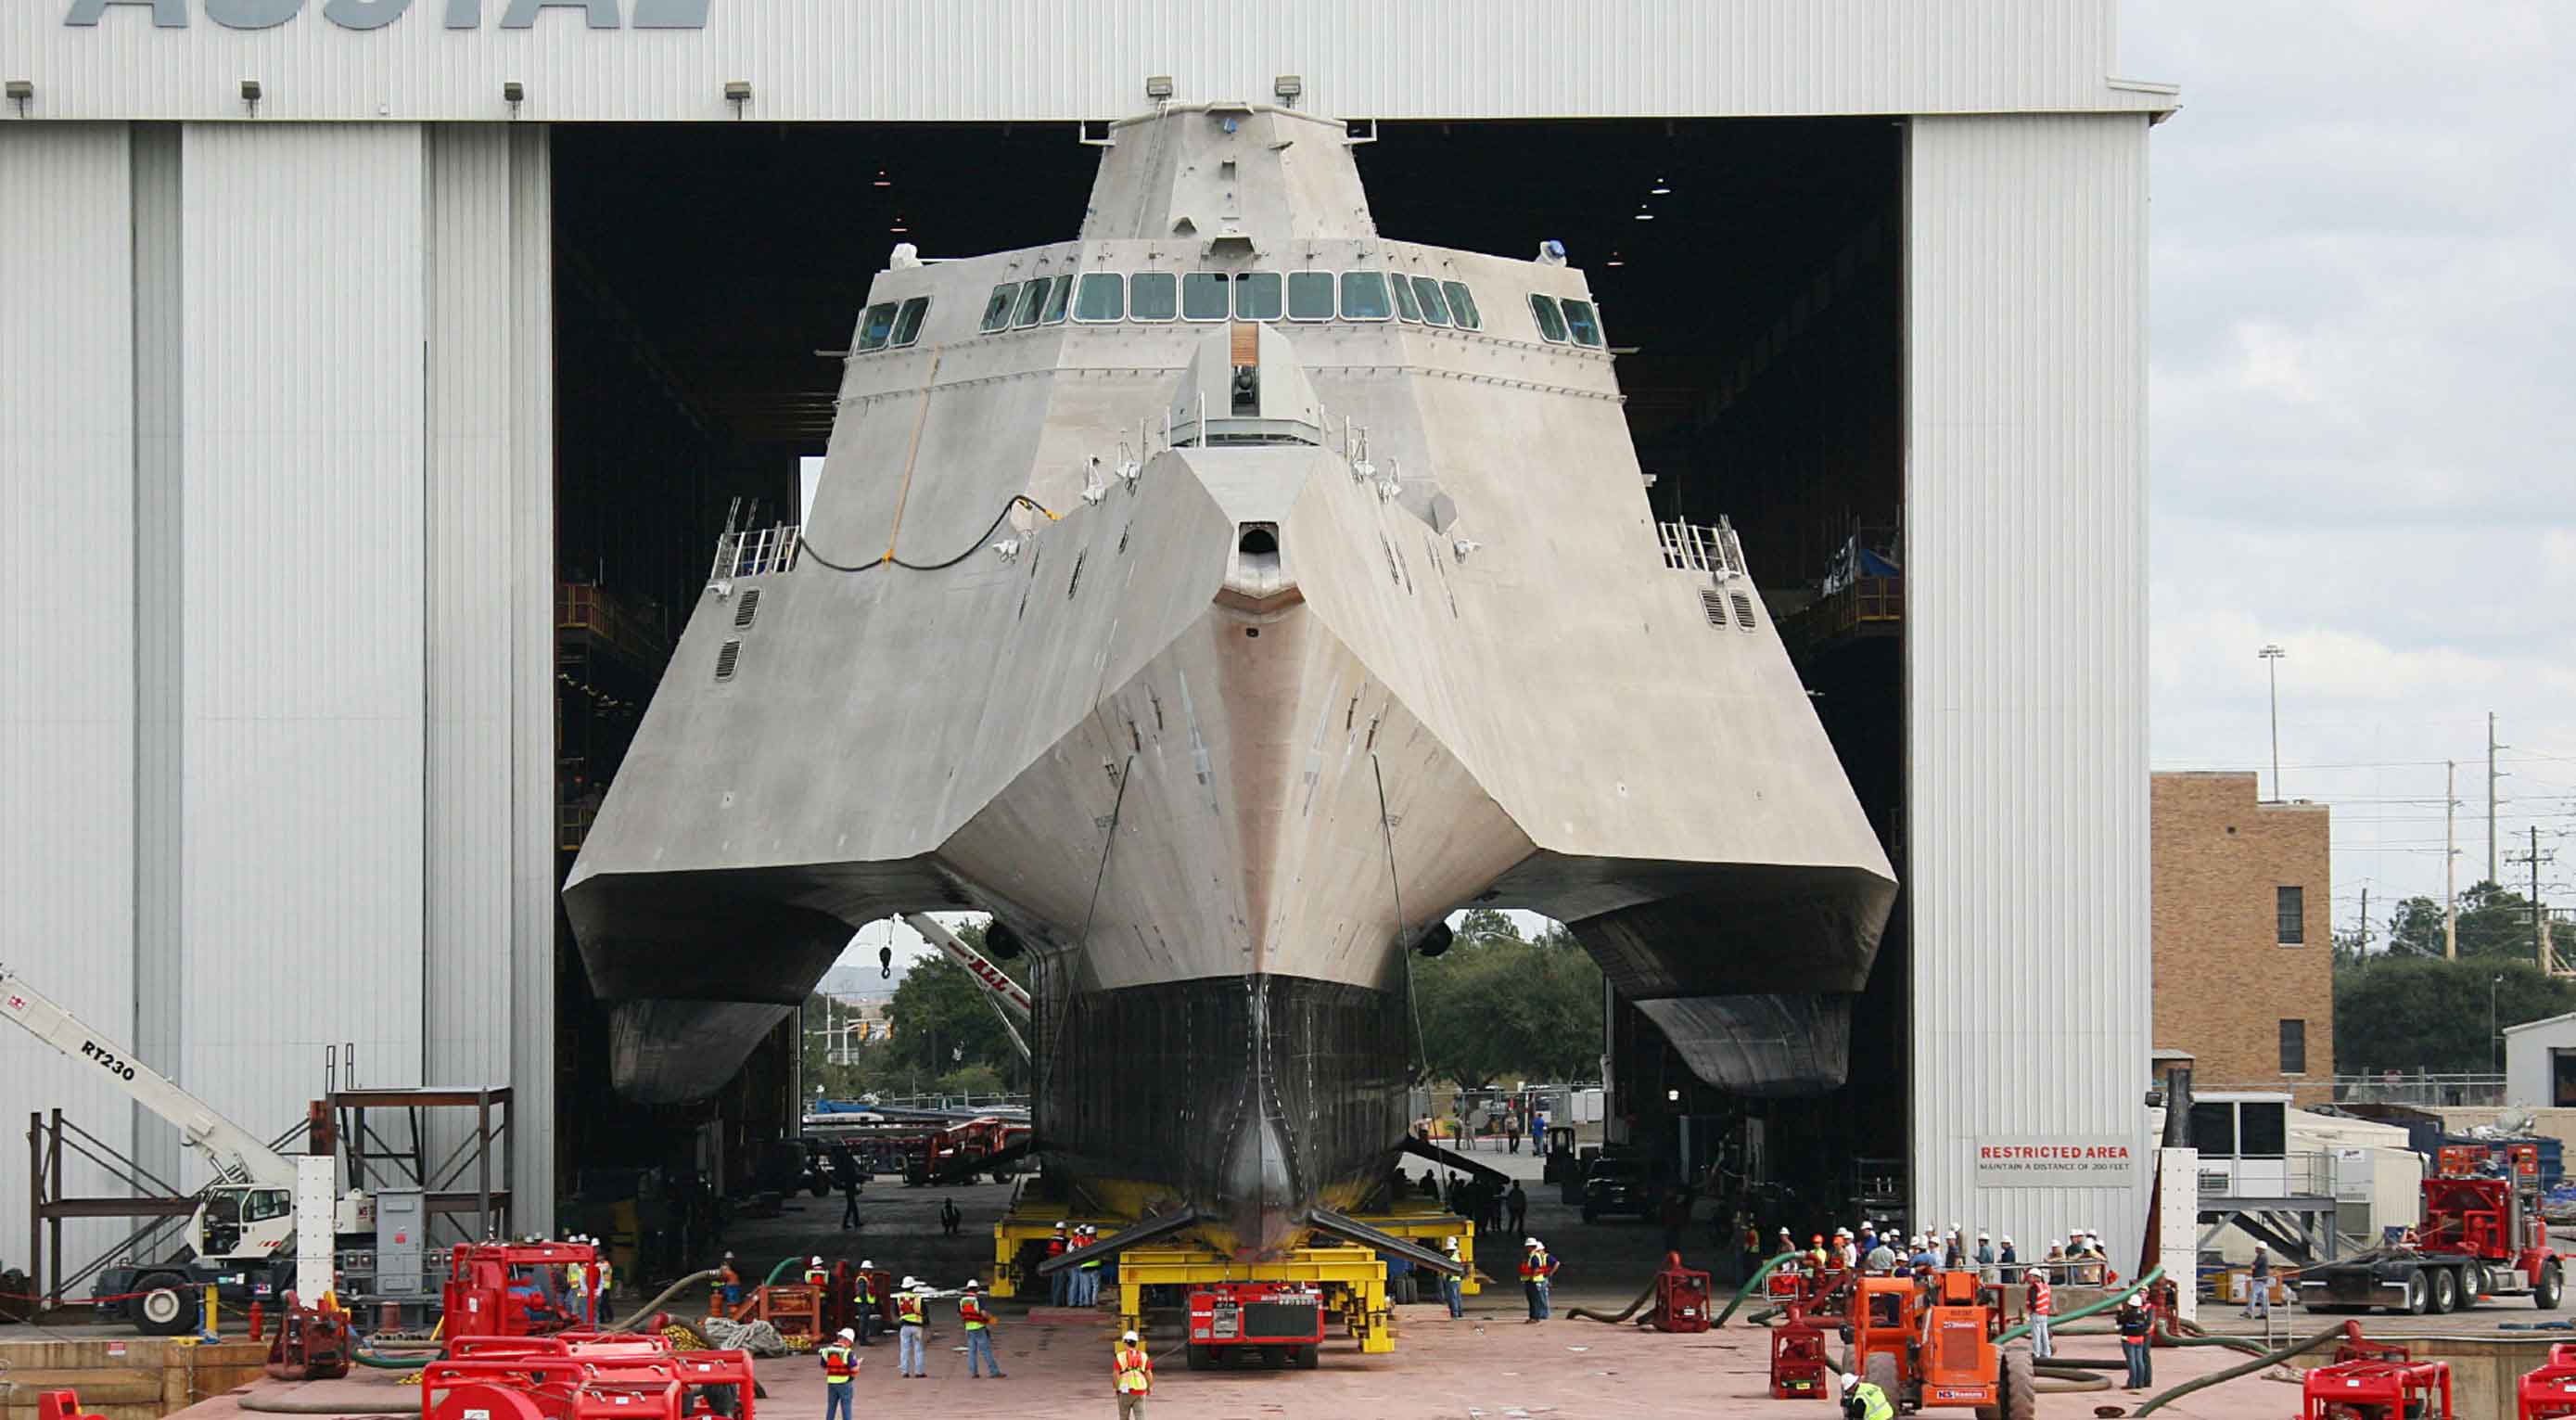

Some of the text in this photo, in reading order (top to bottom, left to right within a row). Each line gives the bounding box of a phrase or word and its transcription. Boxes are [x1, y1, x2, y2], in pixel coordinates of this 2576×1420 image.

[81, 1040, 135, 1081] RT230
[1981, 1145, 2130, 1158] RESTRICTED AREA
[1980, 1163, 2130, 1171] MAINTAIN A DISTANCE OF 200 FEET
